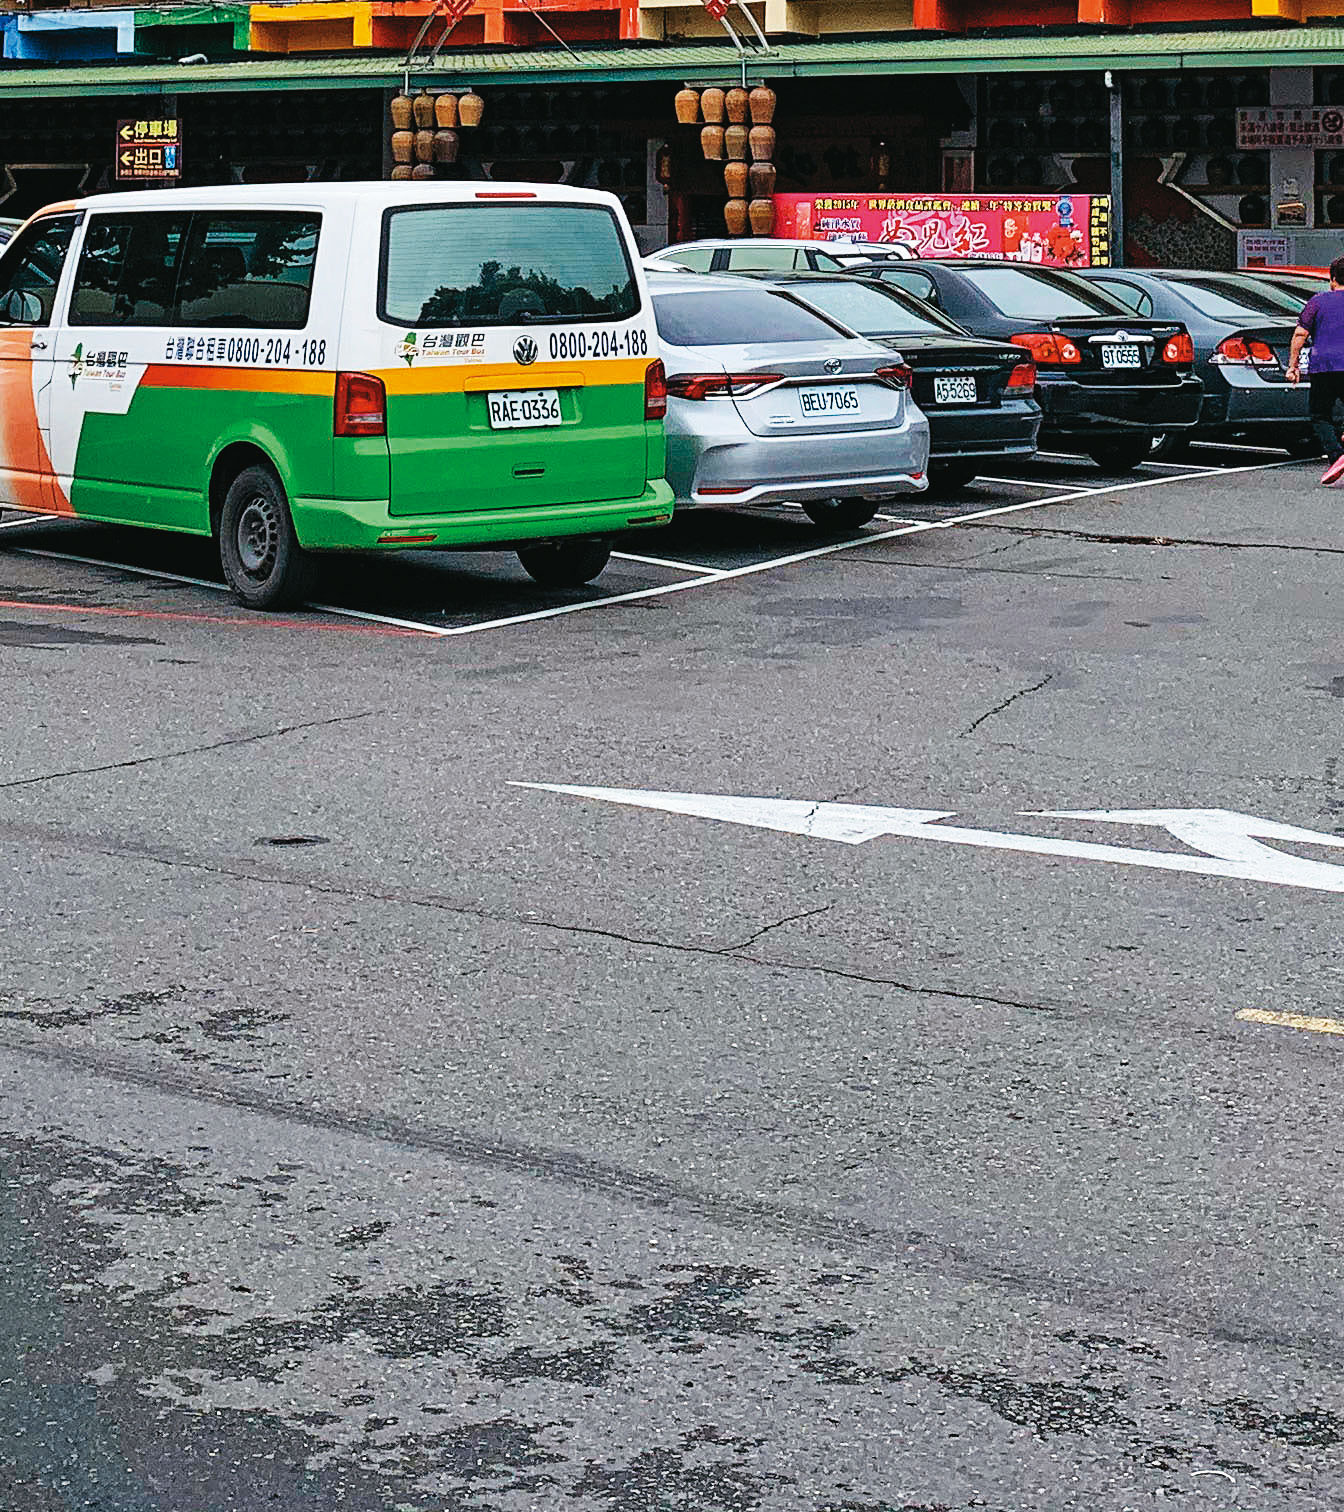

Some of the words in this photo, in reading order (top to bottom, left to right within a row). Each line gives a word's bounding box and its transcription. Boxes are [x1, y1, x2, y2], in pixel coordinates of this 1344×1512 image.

[134, 147, 162, 165] 出口
[548, 329, 648, 360] 0800-204-188
[491, 398, 560, 424] RAE-0336
[801, 390, 860, 412] BEU-7065
